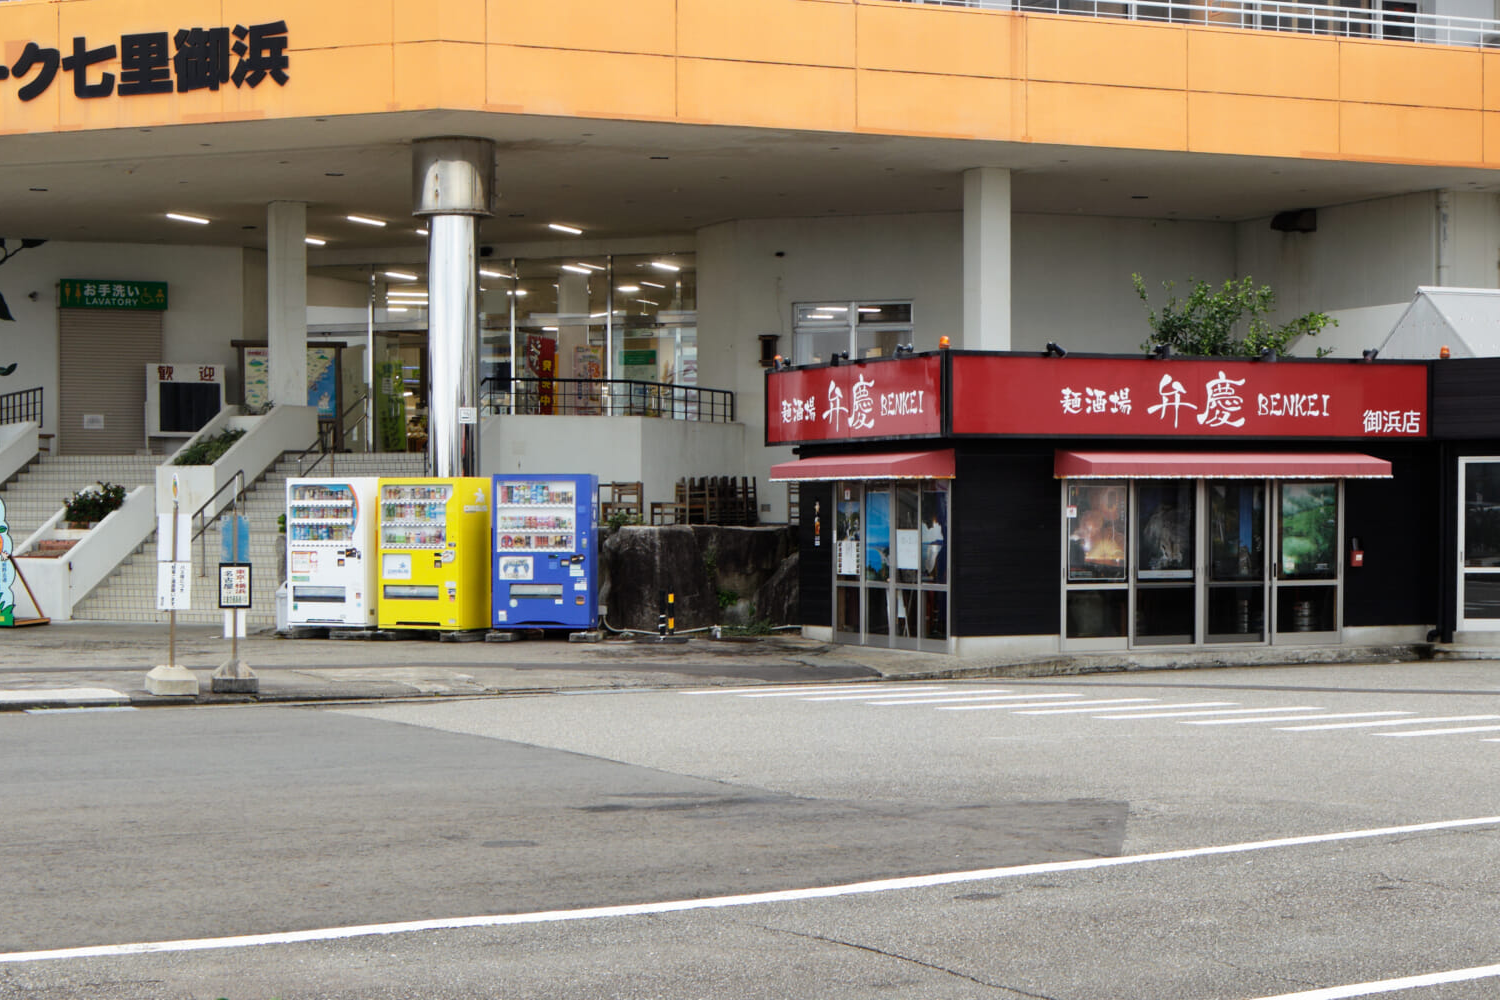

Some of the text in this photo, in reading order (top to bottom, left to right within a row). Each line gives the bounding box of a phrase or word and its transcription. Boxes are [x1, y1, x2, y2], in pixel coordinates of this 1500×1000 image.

[83, 283, 141, 297] お手洗い
[85, 297, 139, 307] LAVATORY
[780, 373, 925, 433] 麺酒場 弁慶 BENKEI
[1060, 370, 1331, 429] 麺酒場 弁慶 BENKEI
[1362, 409, 1421, 434] 御浜店
